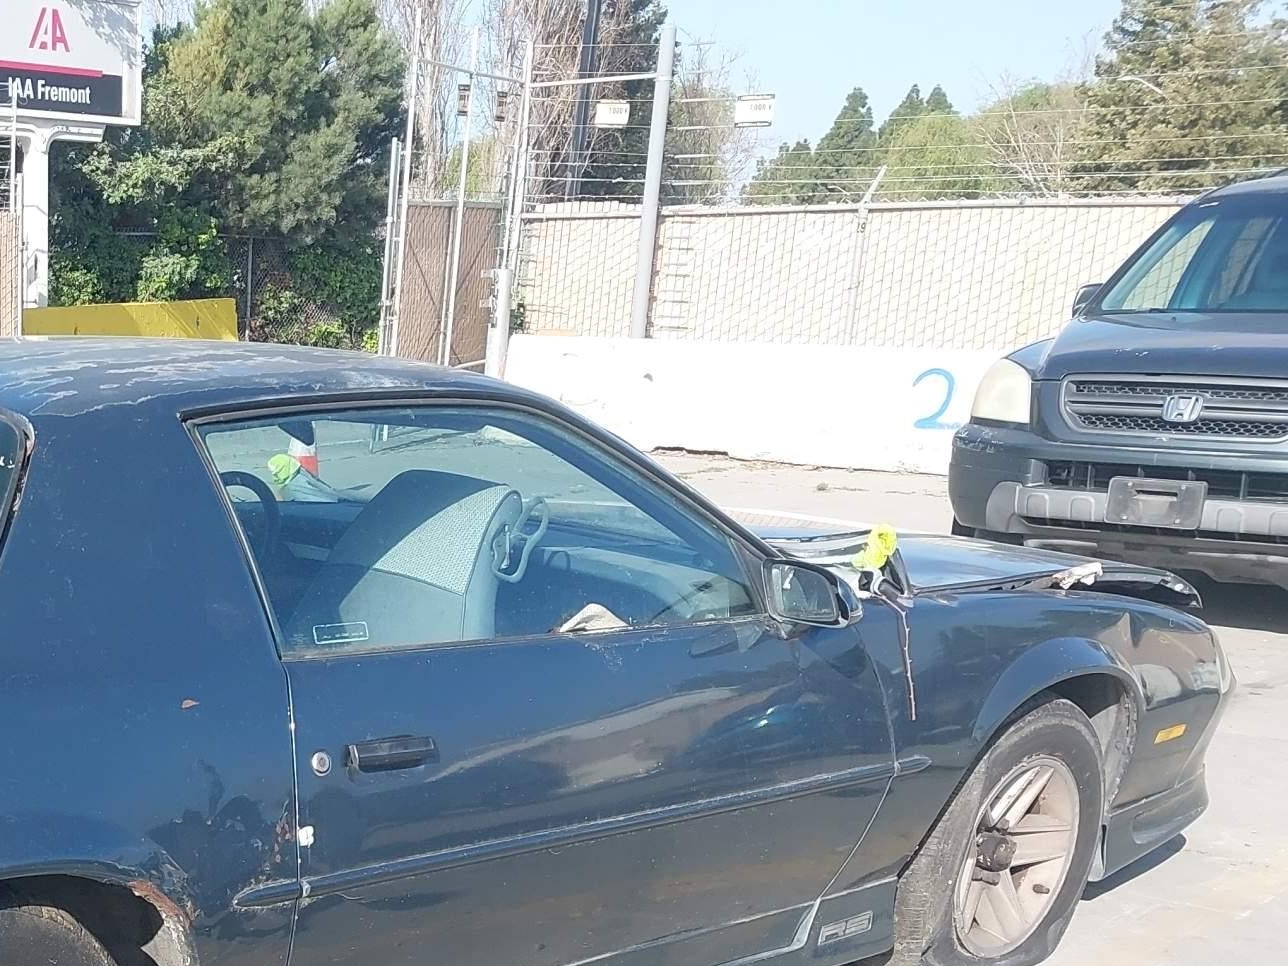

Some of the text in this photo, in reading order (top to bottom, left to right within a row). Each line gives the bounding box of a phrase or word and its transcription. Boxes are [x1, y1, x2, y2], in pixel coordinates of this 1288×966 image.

[8, 76, 91, 104] IAA Fremont
[912, 367, 955, 429] 2
